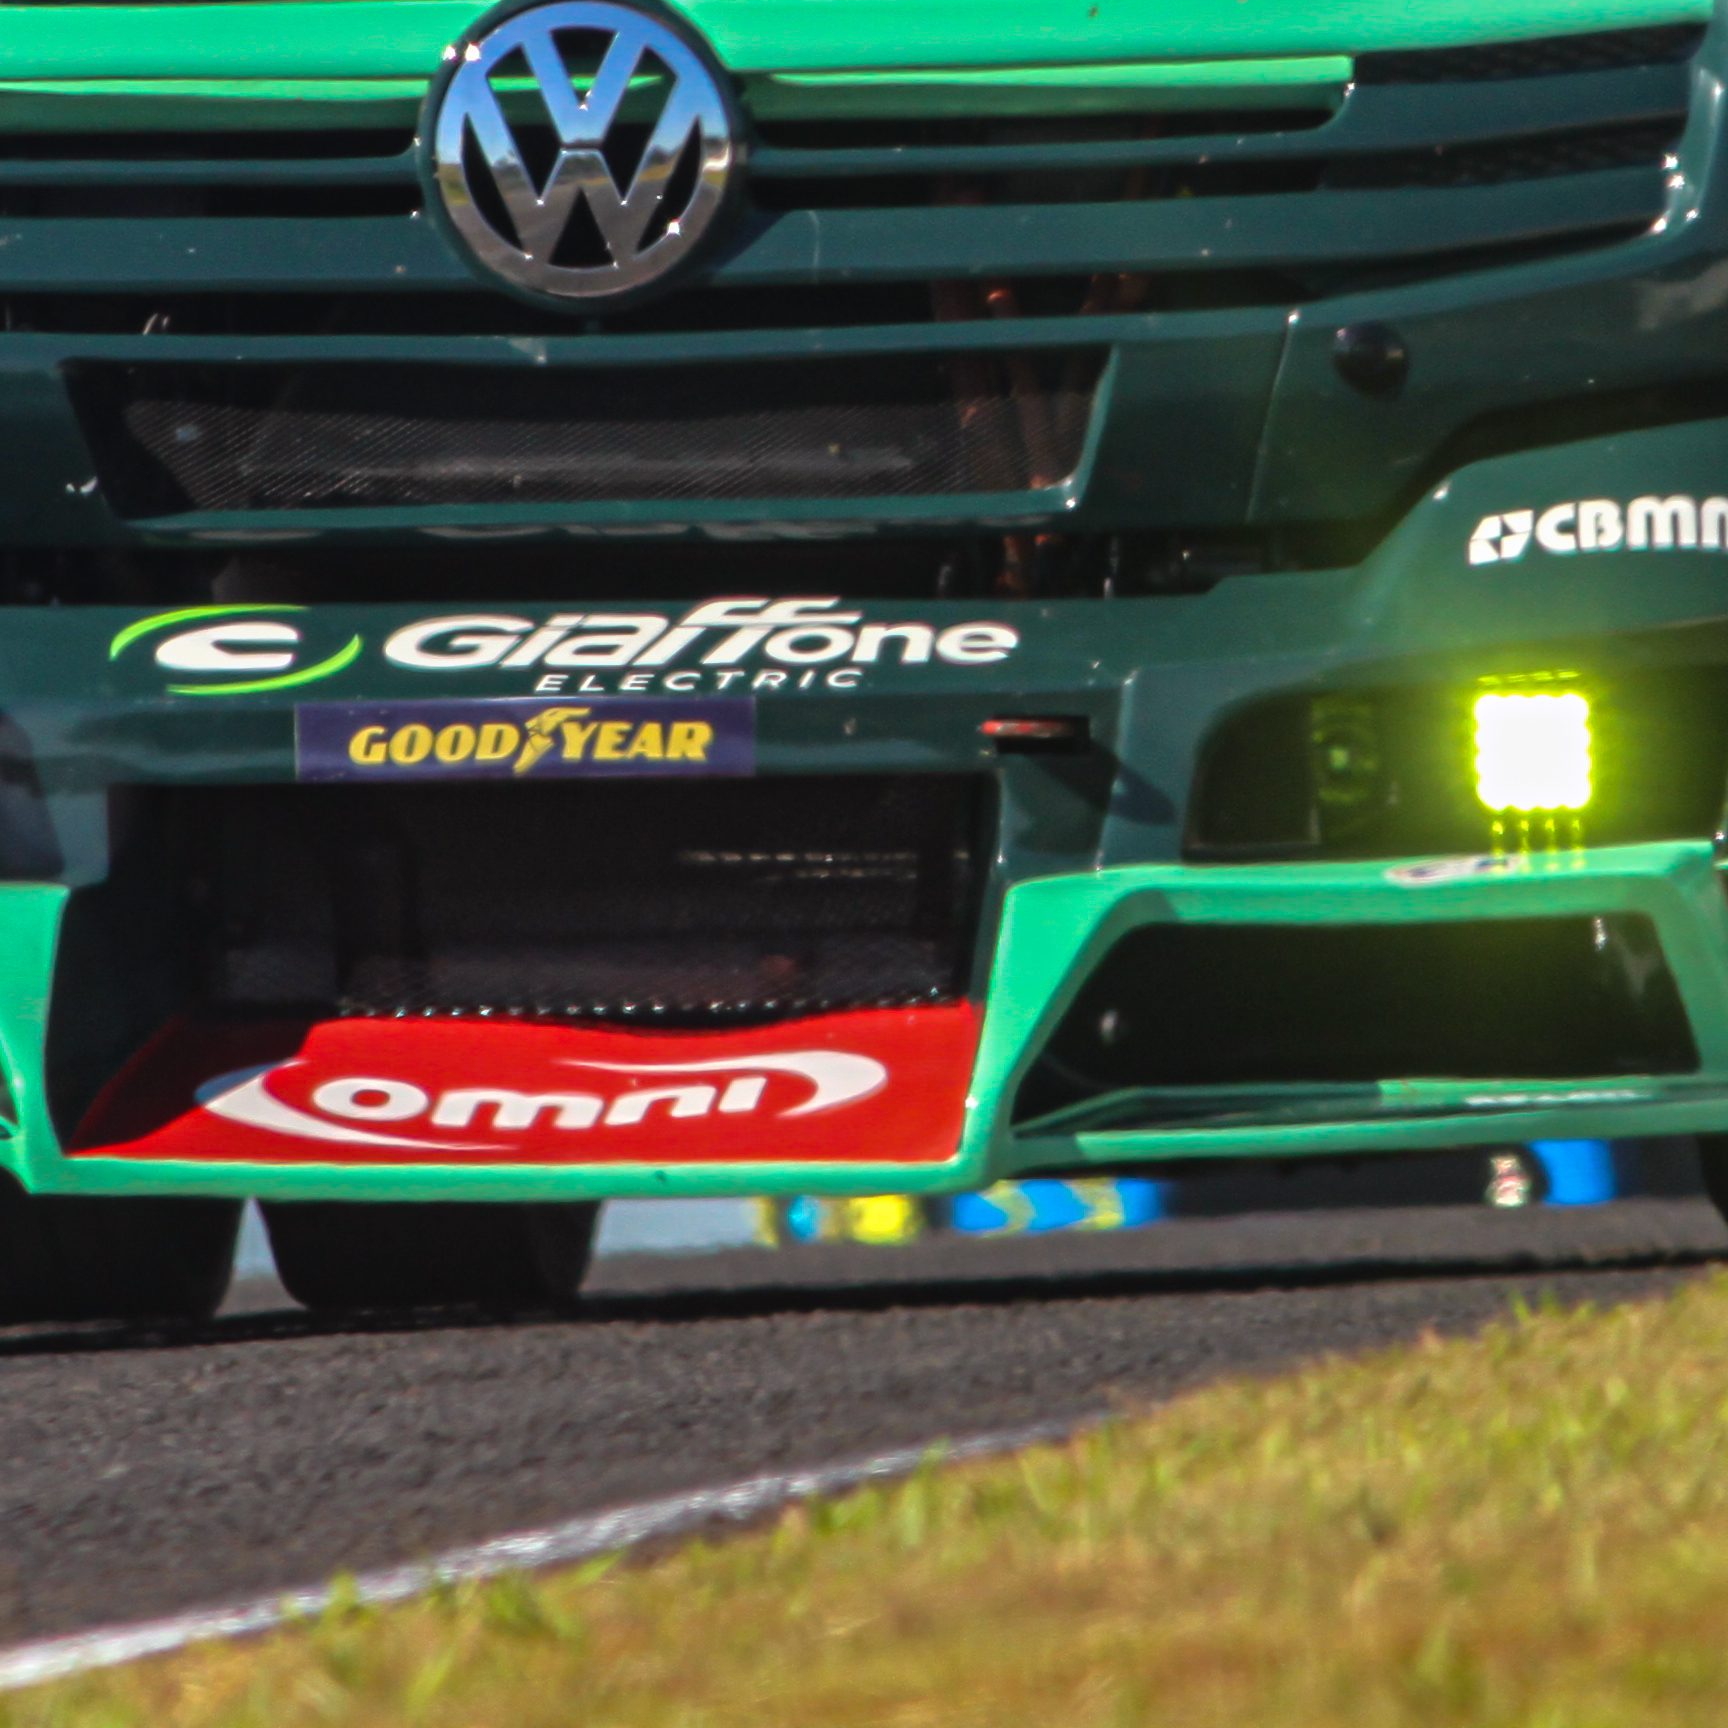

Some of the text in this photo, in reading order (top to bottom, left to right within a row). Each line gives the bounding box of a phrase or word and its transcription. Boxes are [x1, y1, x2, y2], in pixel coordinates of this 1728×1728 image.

[383, 596, 1019, 669] Giaffone
[534, 668, 864, 692] ELECTRIC
[312, 1076, 768, 1130] omni
